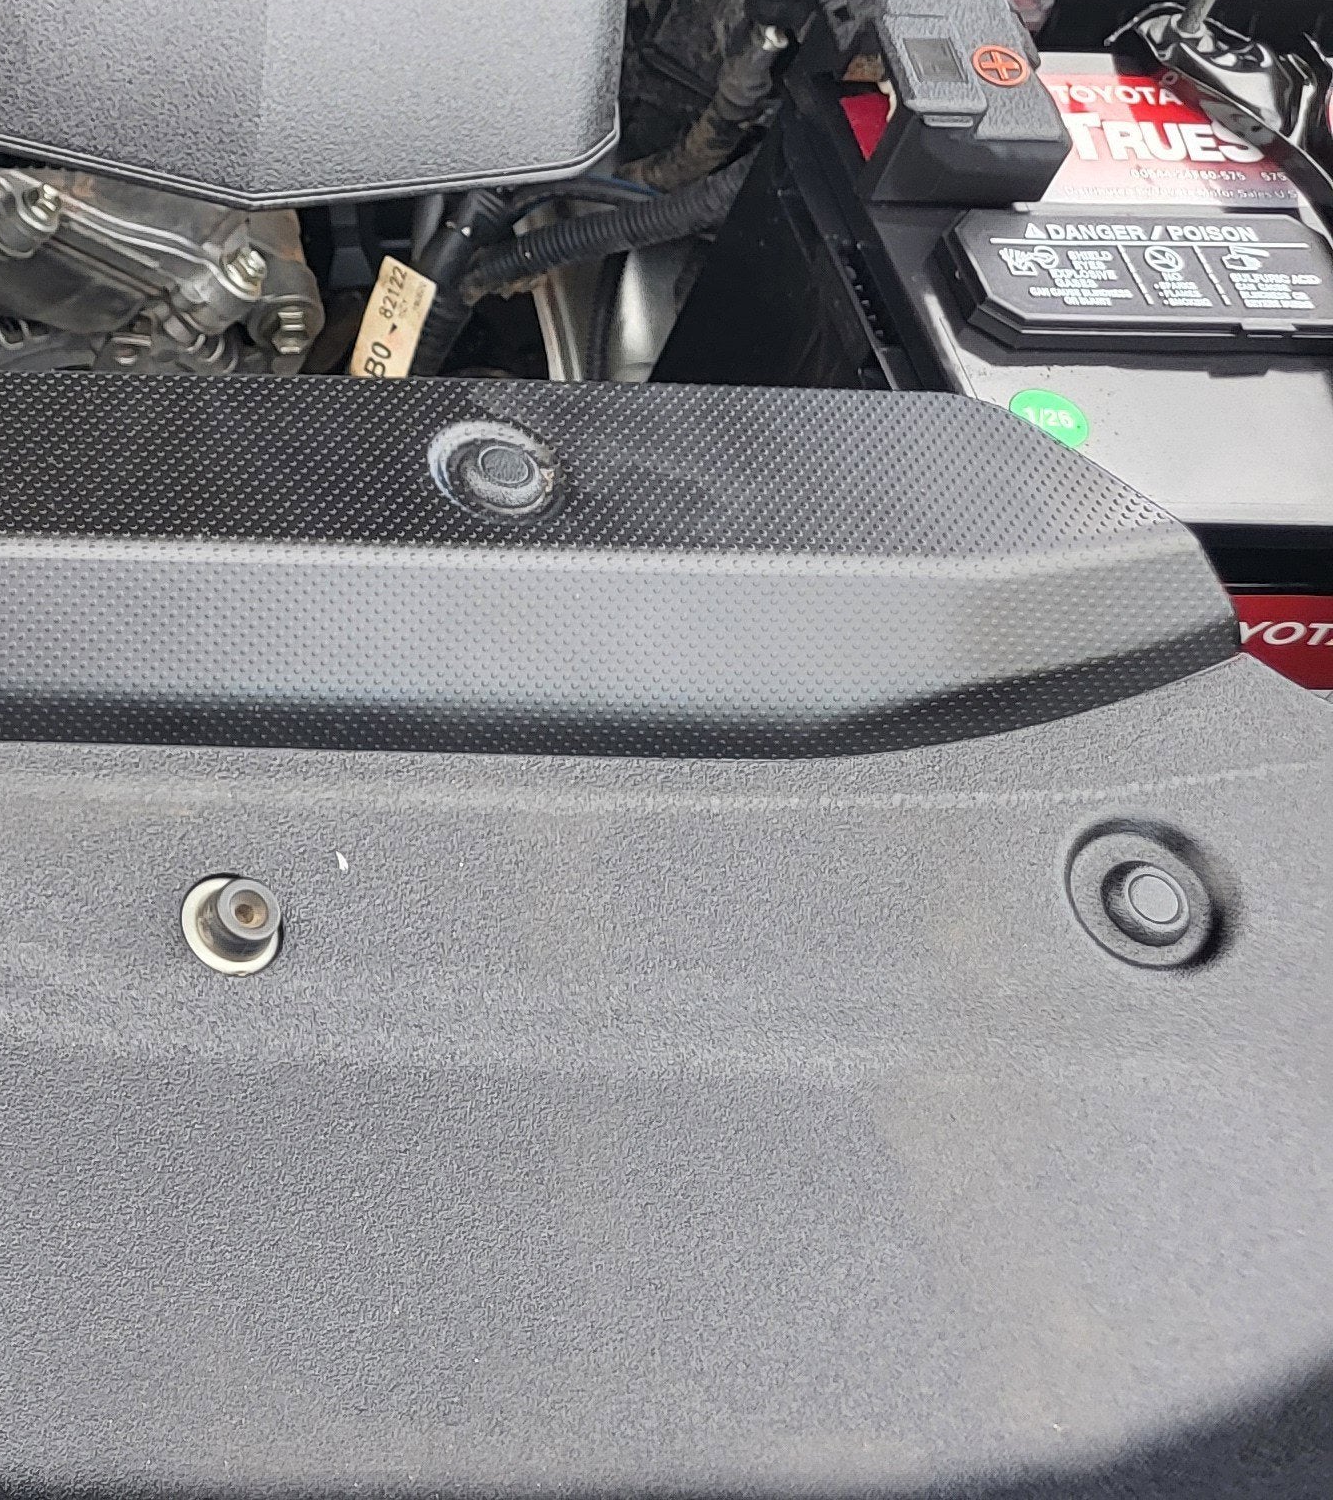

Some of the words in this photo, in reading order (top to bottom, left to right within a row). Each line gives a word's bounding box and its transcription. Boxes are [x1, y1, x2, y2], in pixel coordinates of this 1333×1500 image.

[1048, 84, 1183, 106] TOYOTA
[1045, 223, 1148, 241] DANGER
[1166, 225, 1259, 242] POISON
[378, 265, 409, 319] 82122
[1021, 405, 1075, 429] 1/26
[1238, 620, 1333, 647] YOT
